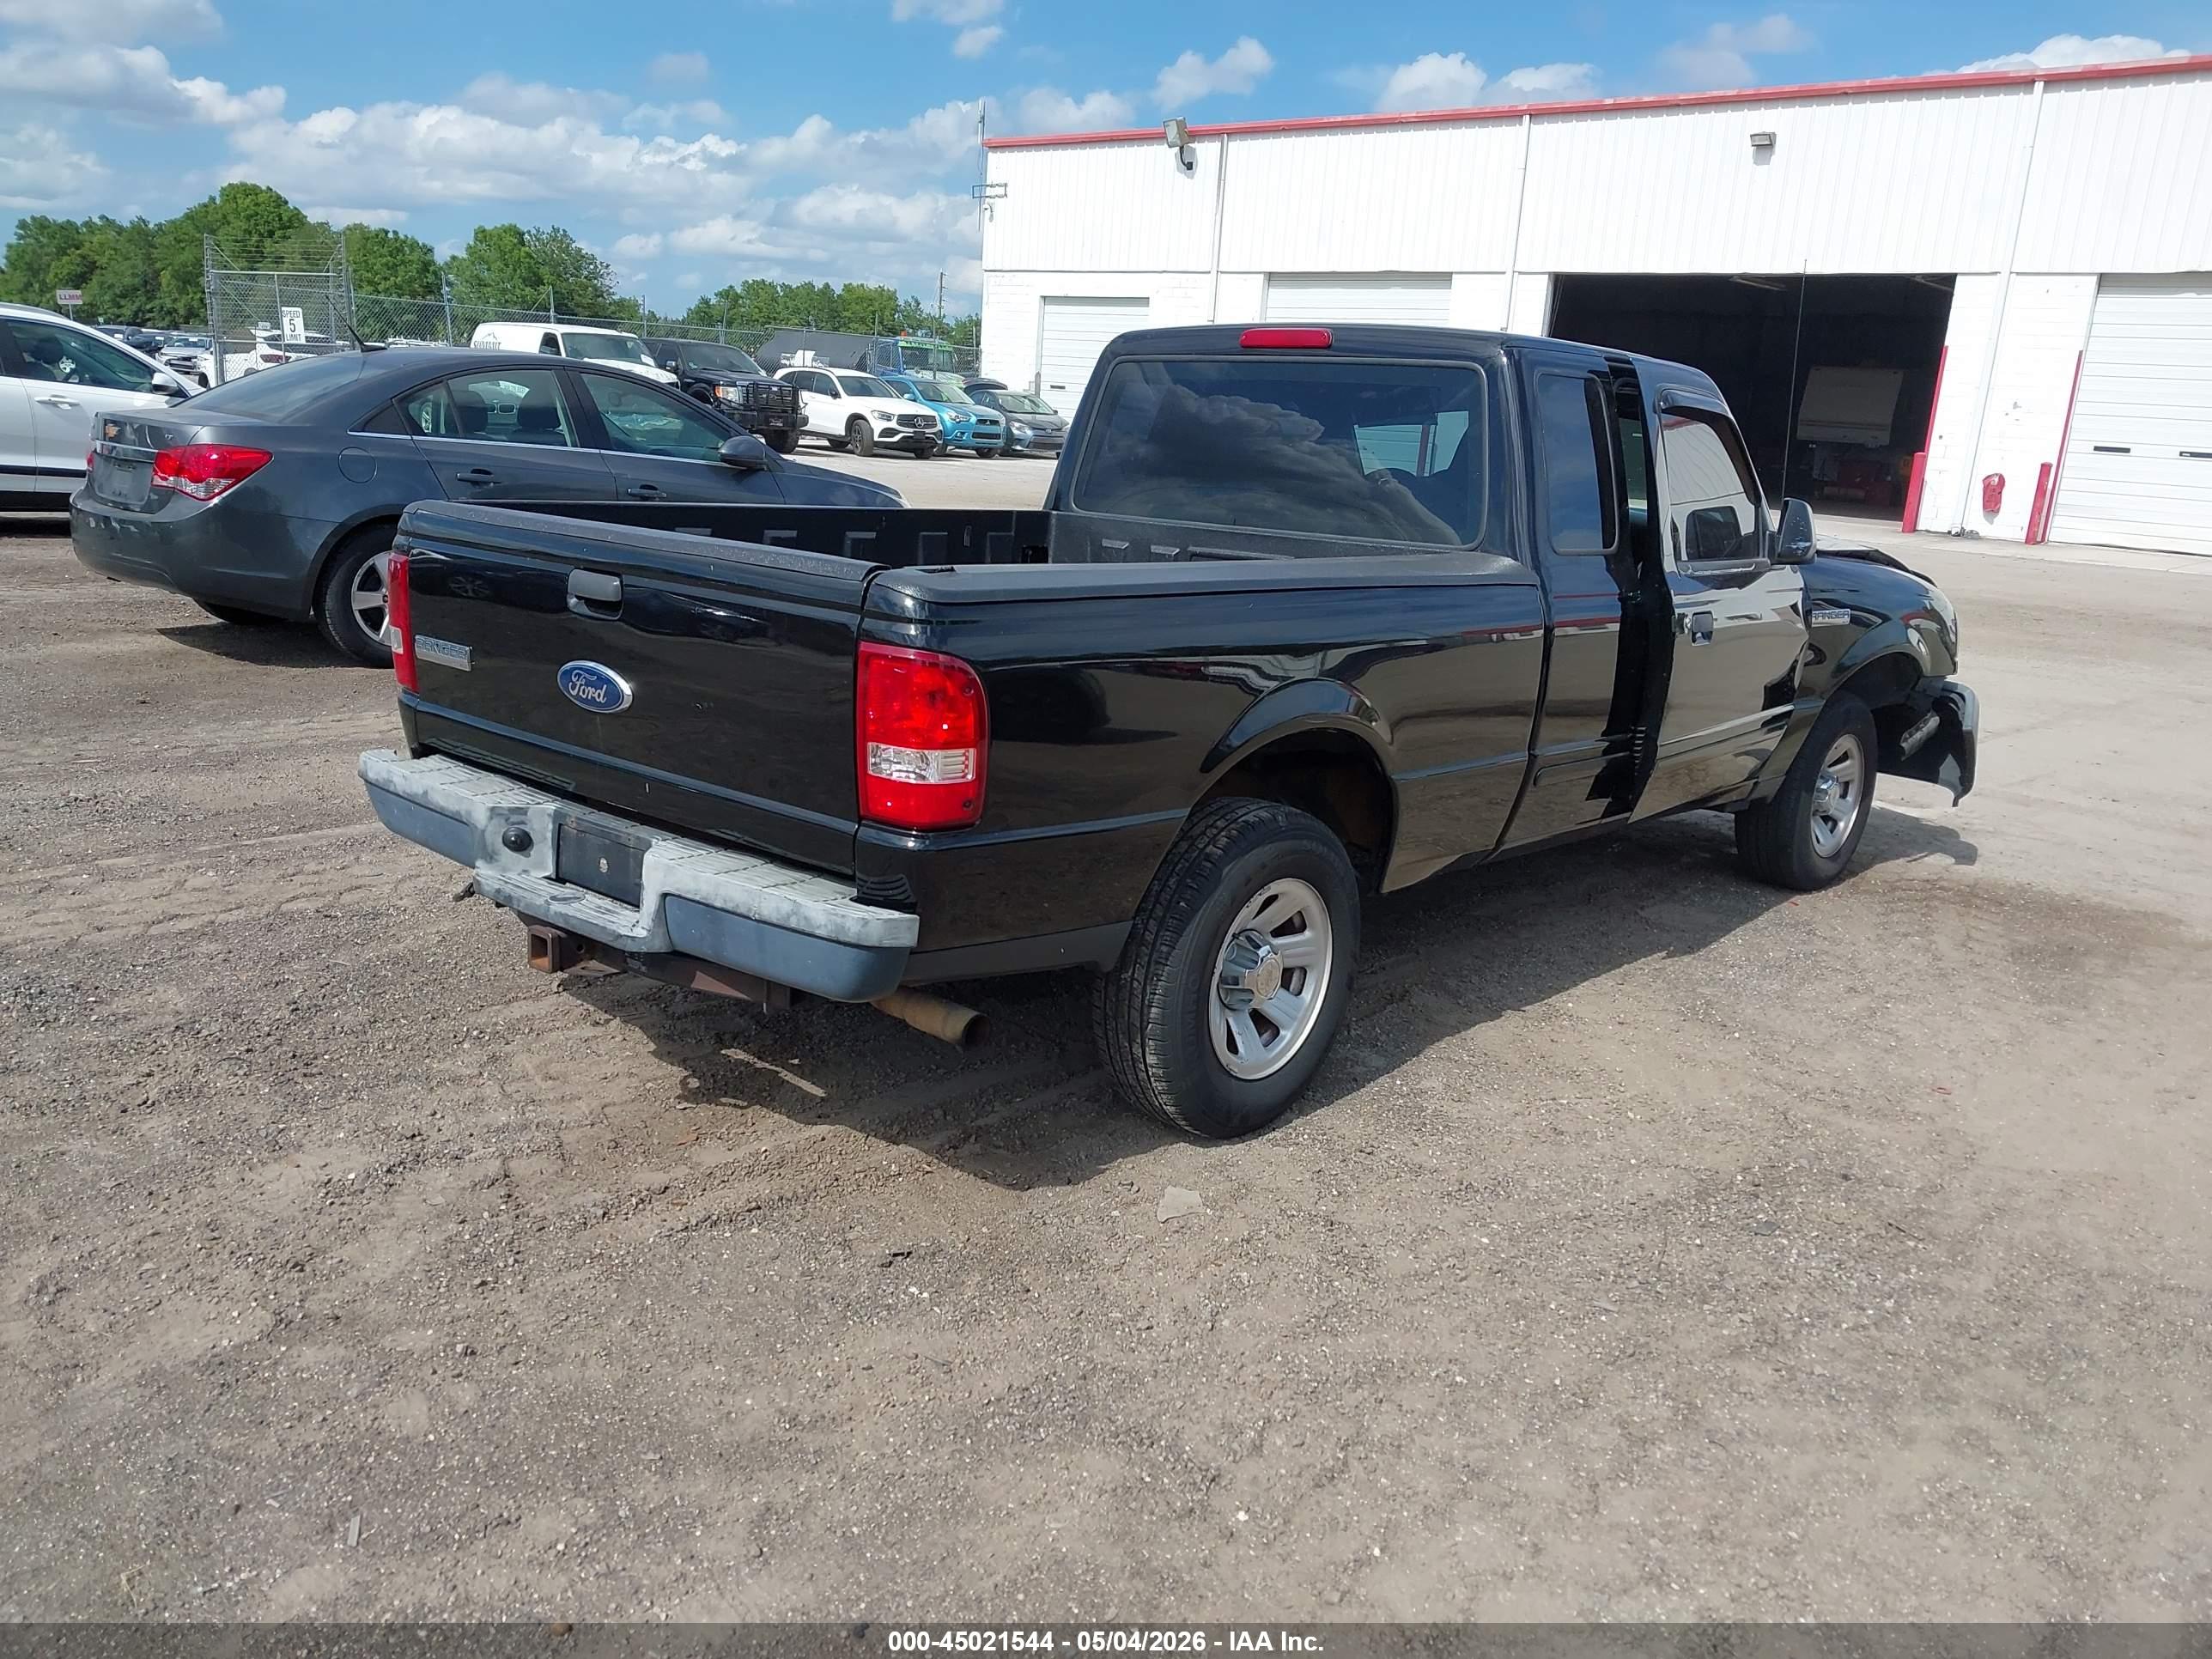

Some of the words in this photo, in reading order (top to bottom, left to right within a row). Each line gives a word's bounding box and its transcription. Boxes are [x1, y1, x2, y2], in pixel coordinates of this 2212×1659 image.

[289, 319, 296, 333] 5
[286, 333, 301, 342] LIMIT
[416, 636, 466, 660] RANGER
[568, 670, 607, 703] Ford
